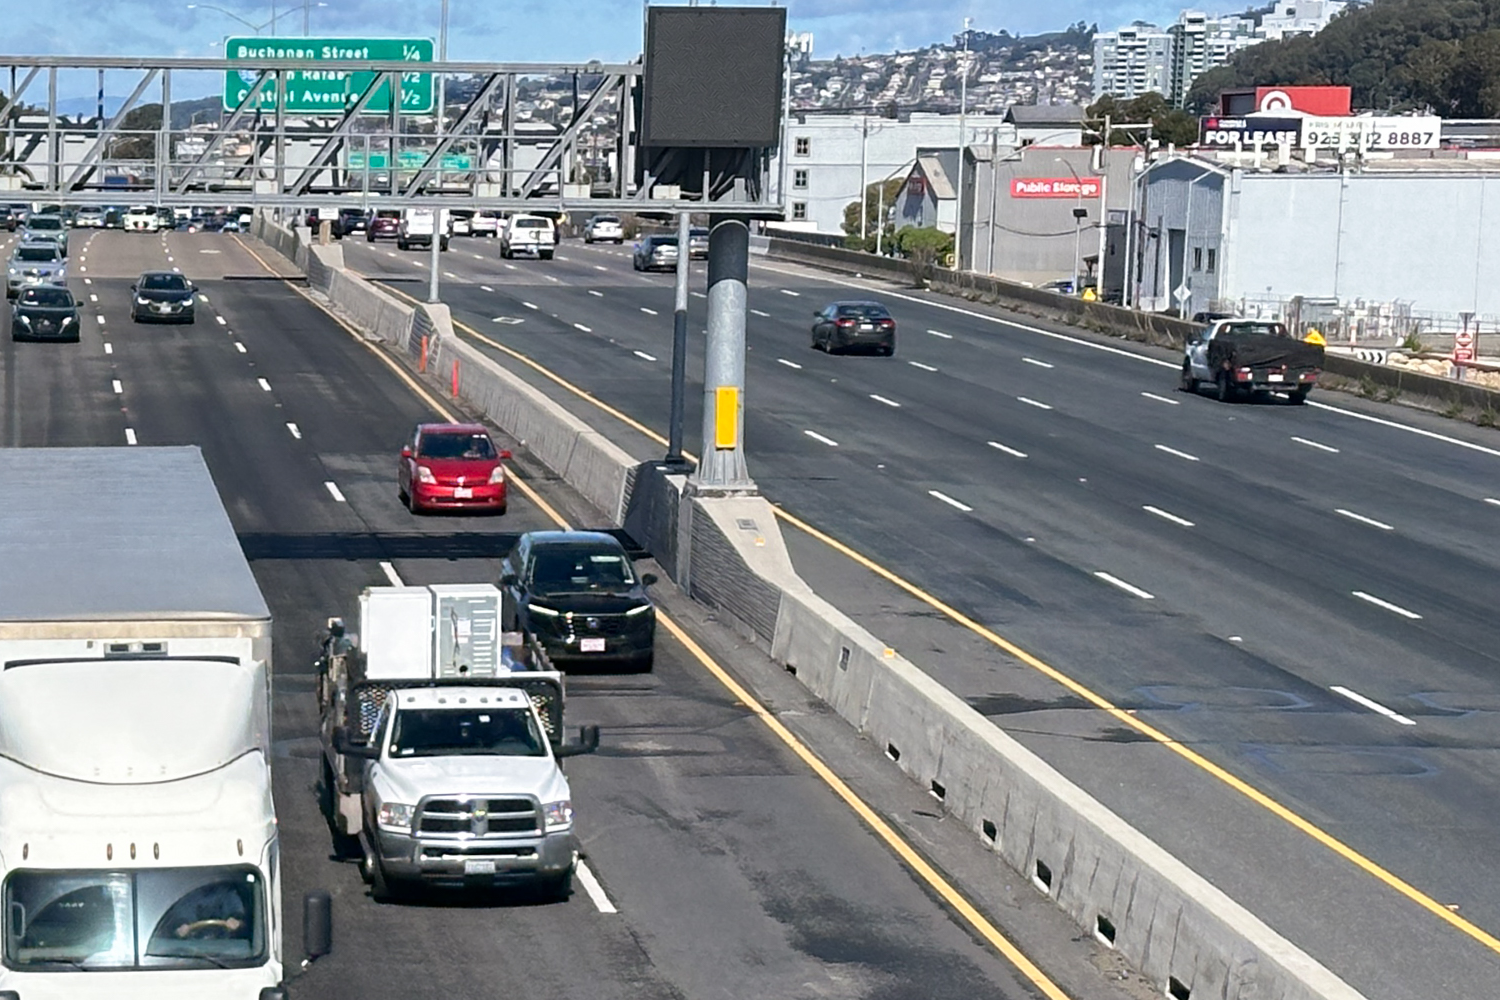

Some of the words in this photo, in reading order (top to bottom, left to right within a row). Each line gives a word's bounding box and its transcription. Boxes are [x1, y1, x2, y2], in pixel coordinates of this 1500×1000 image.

[237, 45, 315, 58] Buchanan
[321, 45, 369, 59] Street
[402, 44, 421, 61] 1/4
[401, 88, 421, 105] 1/2
[1205, 130, 1242, 145] FOR
[1243, 130, 1297, 145] LEASE
[1387, 131, 1434, 145] 8887
[1016, 181, 1051, 193] Public
